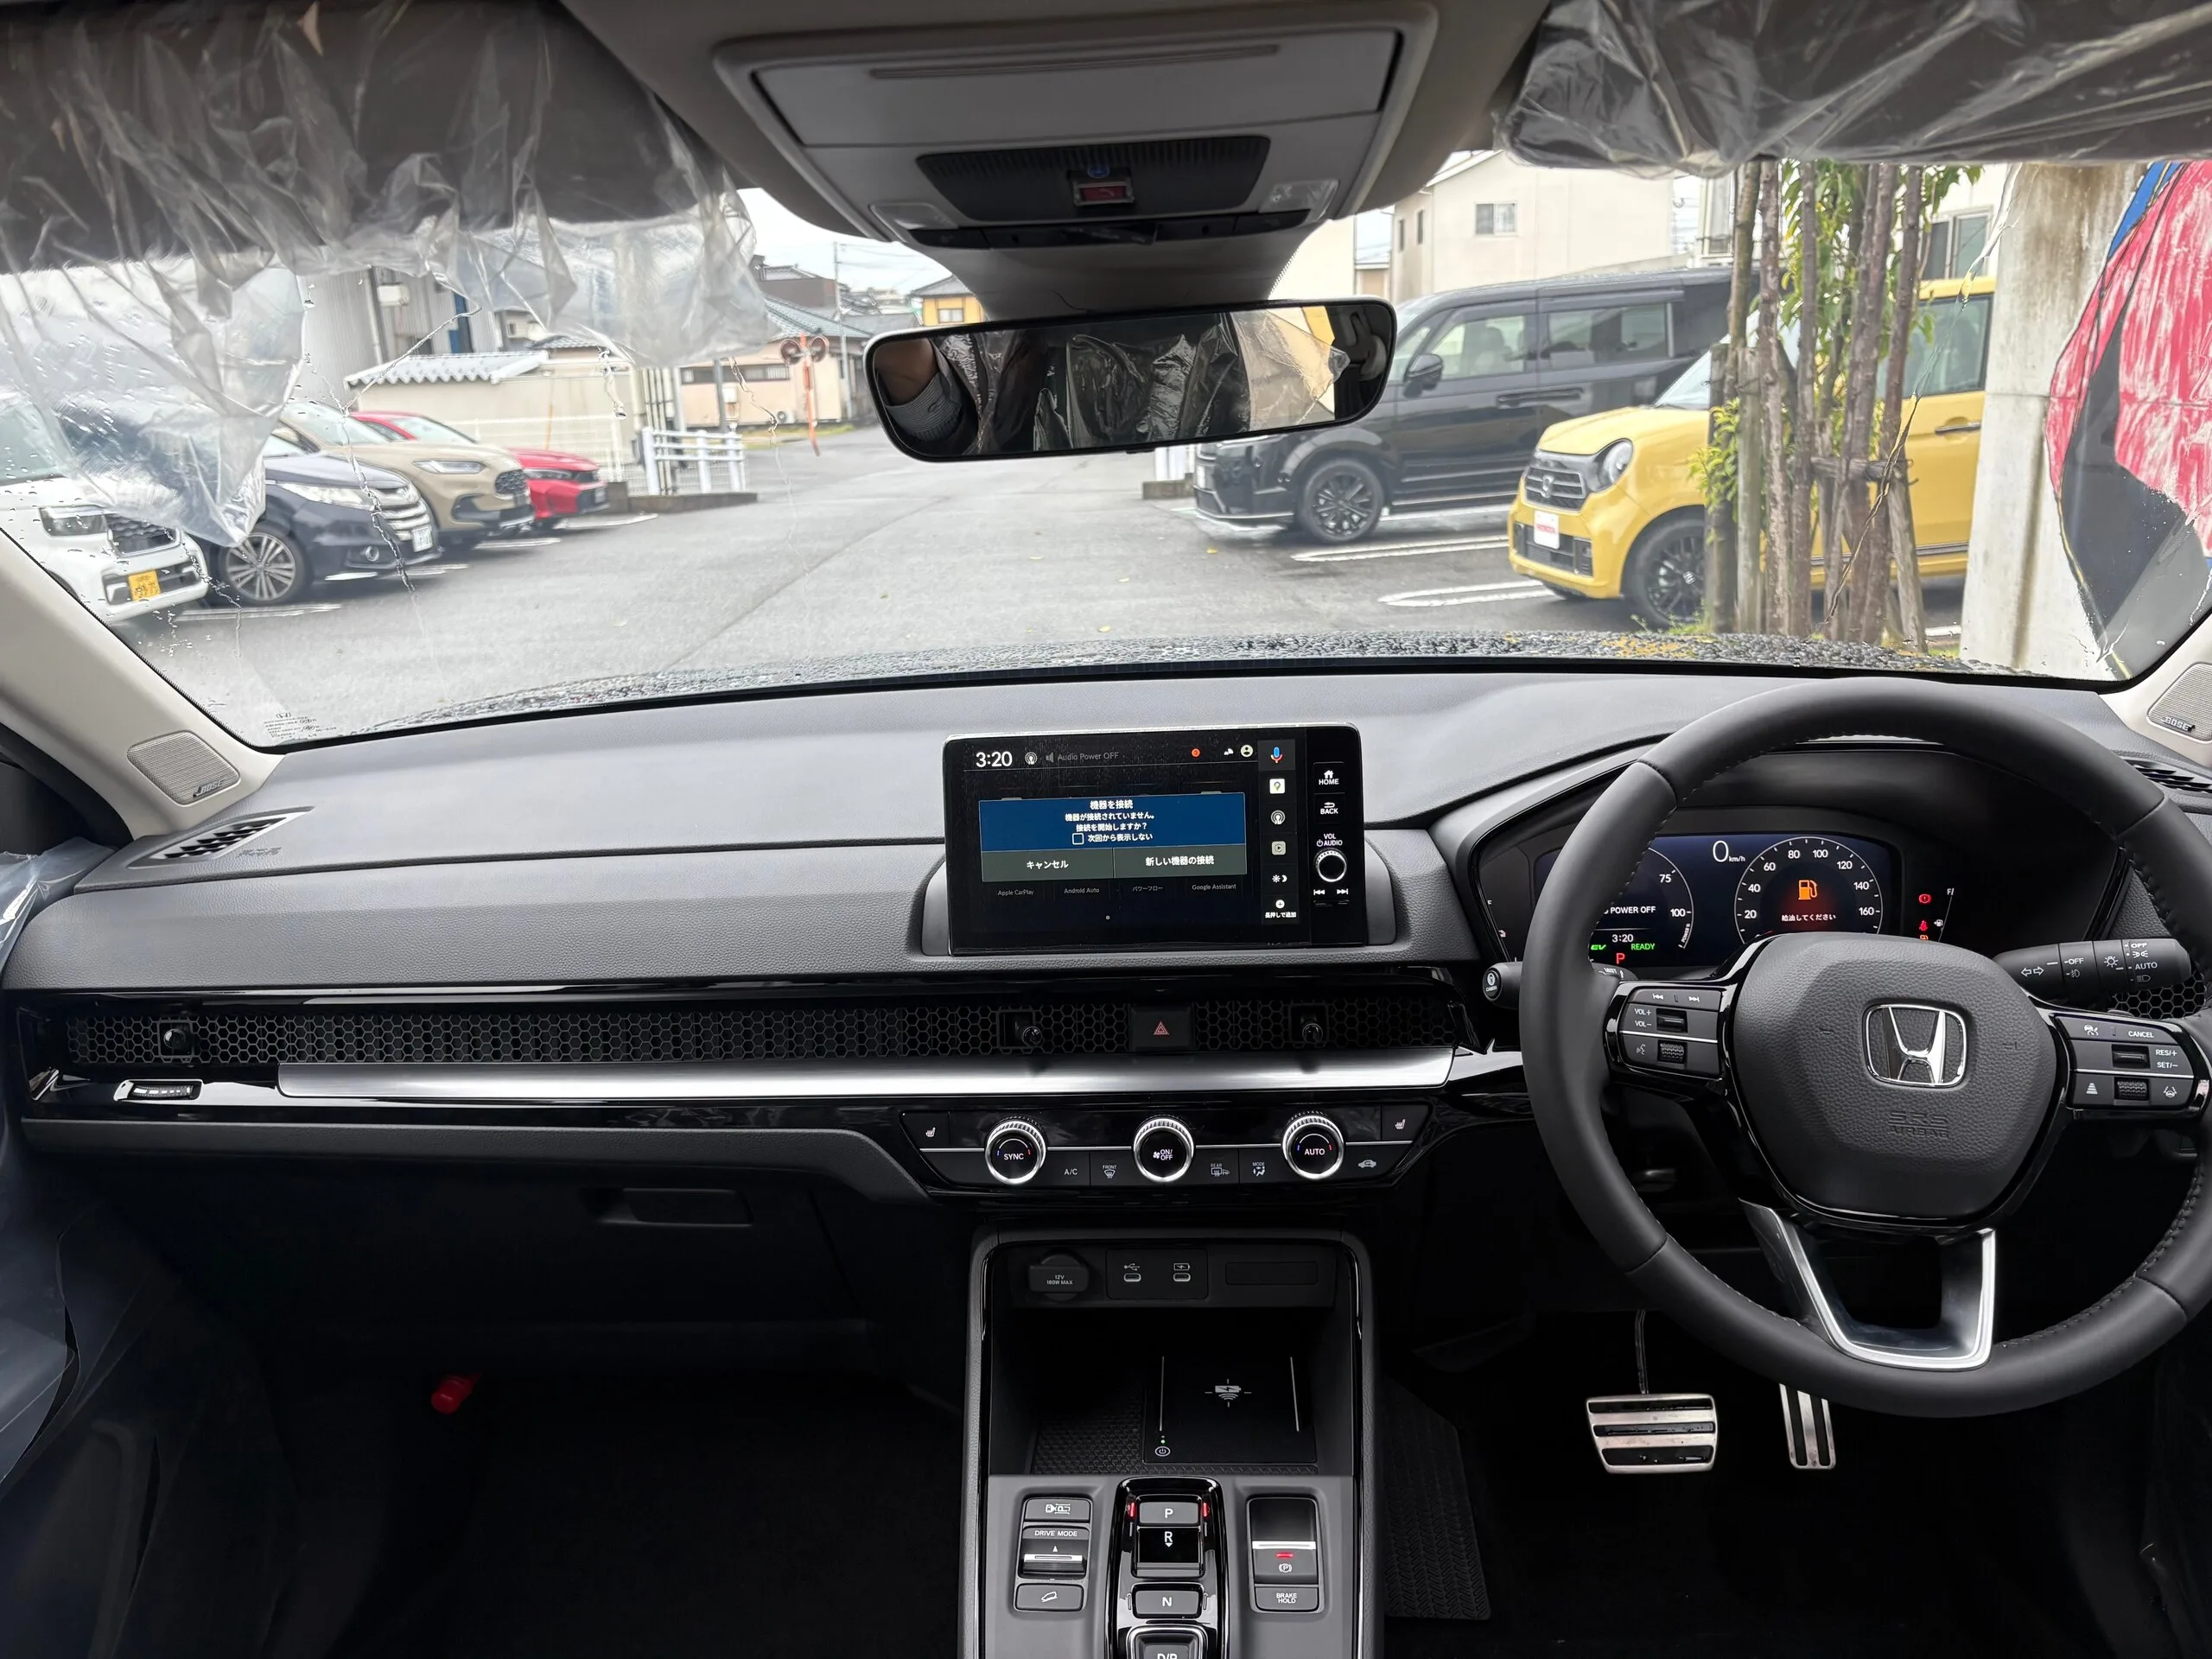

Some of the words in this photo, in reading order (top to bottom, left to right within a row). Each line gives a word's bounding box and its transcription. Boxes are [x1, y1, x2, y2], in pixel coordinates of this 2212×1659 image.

[2165, 717, 2192, 732] BOSE
[976, 751, 1013, 768] 3:20
[1057, 753, 1077, 761] Audio
[1080, 752, 1102, 760] Power
[1090, 799, 1134, 810] 機器を接続
[1065, 811, 1154, 822] 機器が接続されていません。
[1076, 822, 1147, 832] 接続を開始しますか？
[1087, 833, 1154, 842] 次回から表示しない
[1713, 840, 1729, 862] 0
[1788, 850, 1801, 860] 80
[1813, 849, 1828, 859] 100
[1026, 860, 1069, 870] キャンセル
[1145, 855, 1215, 867] 新しい機器の接続
[1836, 861, 1853, 870] 120
[1764, 862, 1777, 872] 60
[1659, 874, 1672, 883] 75
[1748, 884, 1761, 893] 40
[1853, 881, 1870, 891] 140
[1670, 908, 1686, 918] 100
[1745, 910, 1758, 919] 20
[1858, 907, 1875, 917] 160
[1781, 913, 1836, 922] 給油してください
[1611, 934, 1634, 943] 3:20
[1616, 952, 1625, 965] P
[2135, 962, 2158, 970] AUTO
[1164, 1508, 1174, 1518] P
[1164, 1531, 1173, 1542] R
[1162, 1597, 1173, 1607] N
